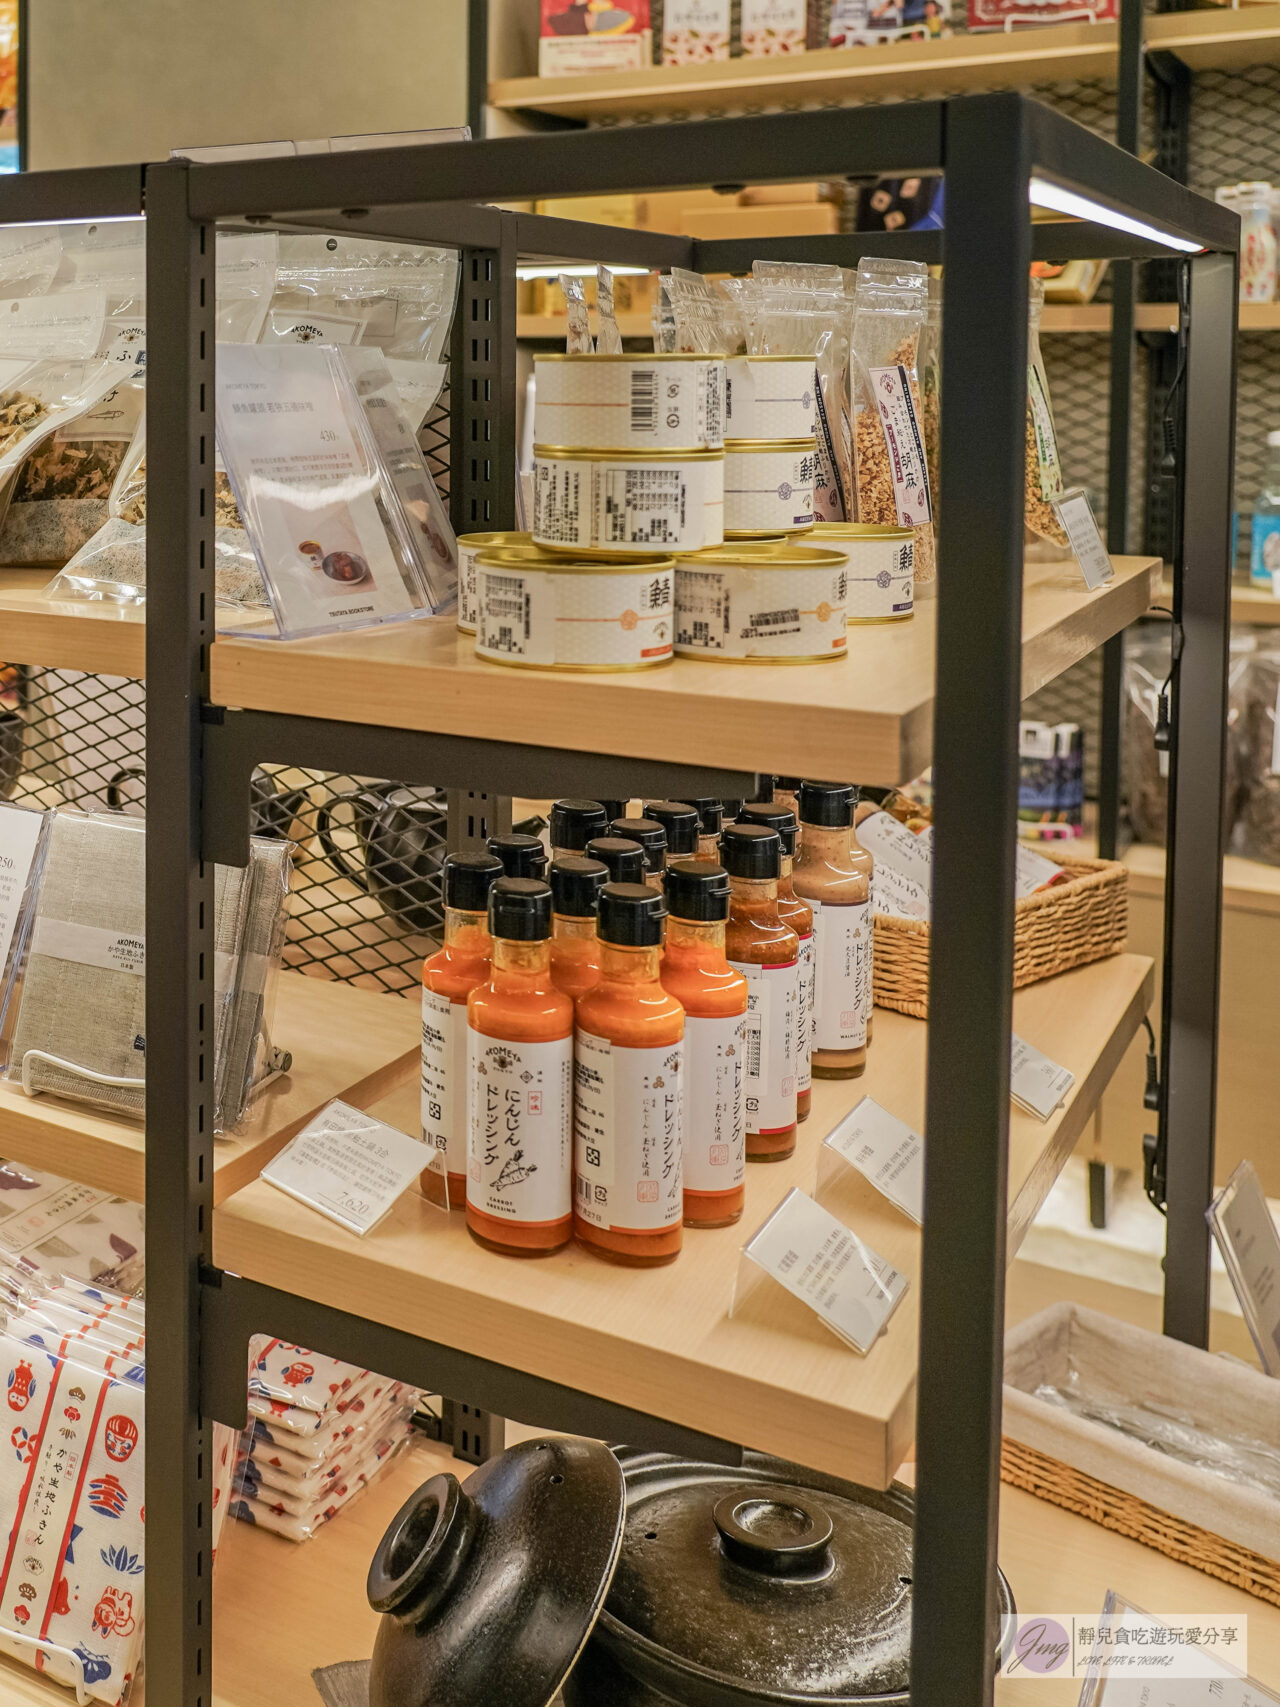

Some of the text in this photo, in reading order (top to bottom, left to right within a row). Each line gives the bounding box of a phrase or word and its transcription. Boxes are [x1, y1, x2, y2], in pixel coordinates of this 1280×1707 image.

[320, 430, 336, 441] 430
[649, 577, 671, 610] 鯖
[117, 939, 144, 949] AKOMEYA
[854, 943, 864, 1010] ドレッシング
[797, 980, 807, 1053] ドレッシング
[485, 1047, 522, 1063] AKOMEYA
[484, 1084, 499, 1165] ドレッシング
[504, 1089, 521, 1147] にんじん
[662, 1094, 674, 1179] ドレッシング
[336, 1191, 370, 1216] 7,620
[486, 1203, 517, 1214] DRESSING
[489, 1196, 513, 1206] CARROT
[34, 1449, 67, 1545] かや生地ふきん
